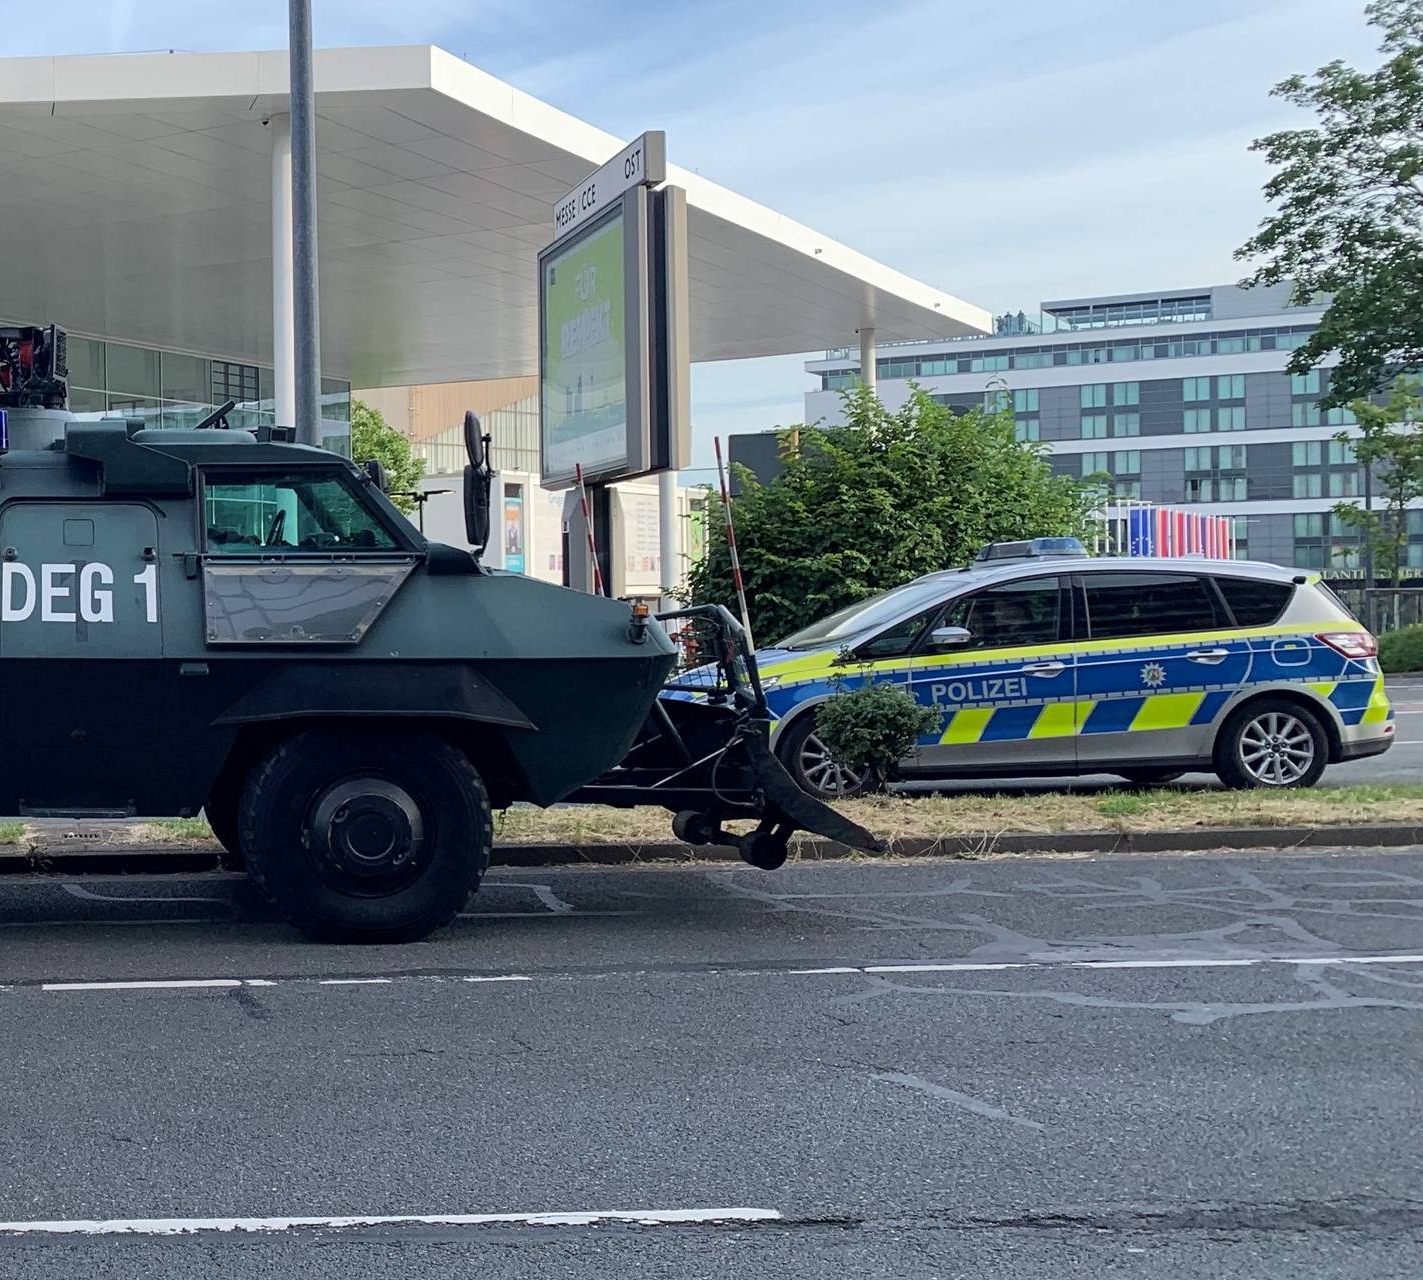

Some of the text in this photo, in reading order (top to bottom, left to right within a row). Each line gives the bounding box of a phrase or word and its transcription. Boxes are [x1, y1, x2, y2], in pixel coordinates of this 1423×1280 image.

[556, 199, 576, 228] MESSE
[582, 184, 596, 211] CCE
[624, 149, 641, 179] OST
[2, 562, 158, 623] DEG 1
[931, 678, 1027, 703] POLIZEI
